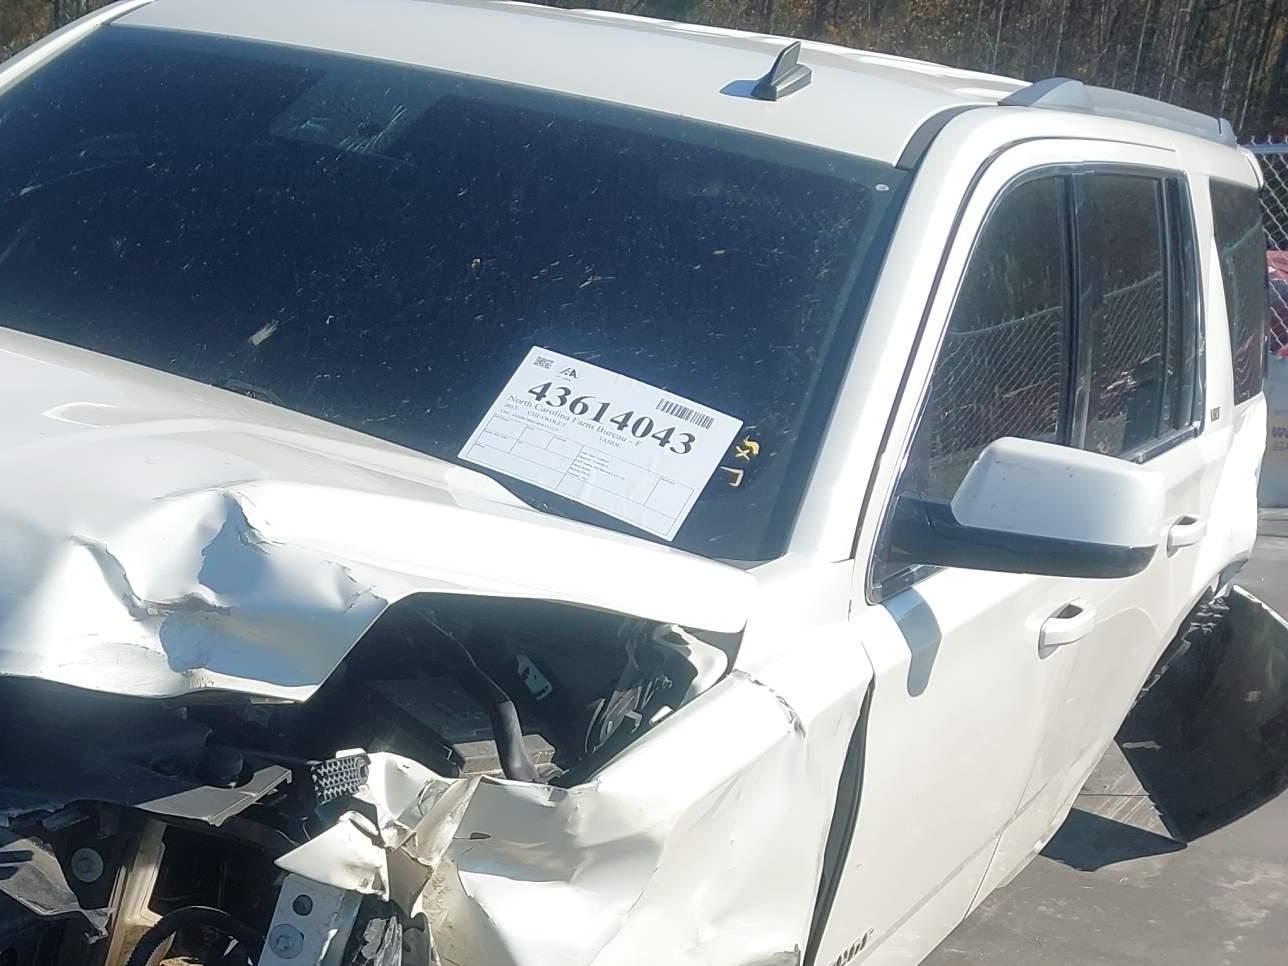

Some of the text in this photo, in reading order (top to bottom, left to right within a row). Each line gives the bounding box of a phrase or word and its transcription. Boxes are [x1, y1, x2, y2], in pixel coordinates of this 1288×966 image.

[507, 394, 532, 408] North
[534, 403, 570, 421] Carolina
[572, 416, 594, 430] Farm
[597, 425, 627, 442] Bureau
[528, 382, 696, 455] 43614043
